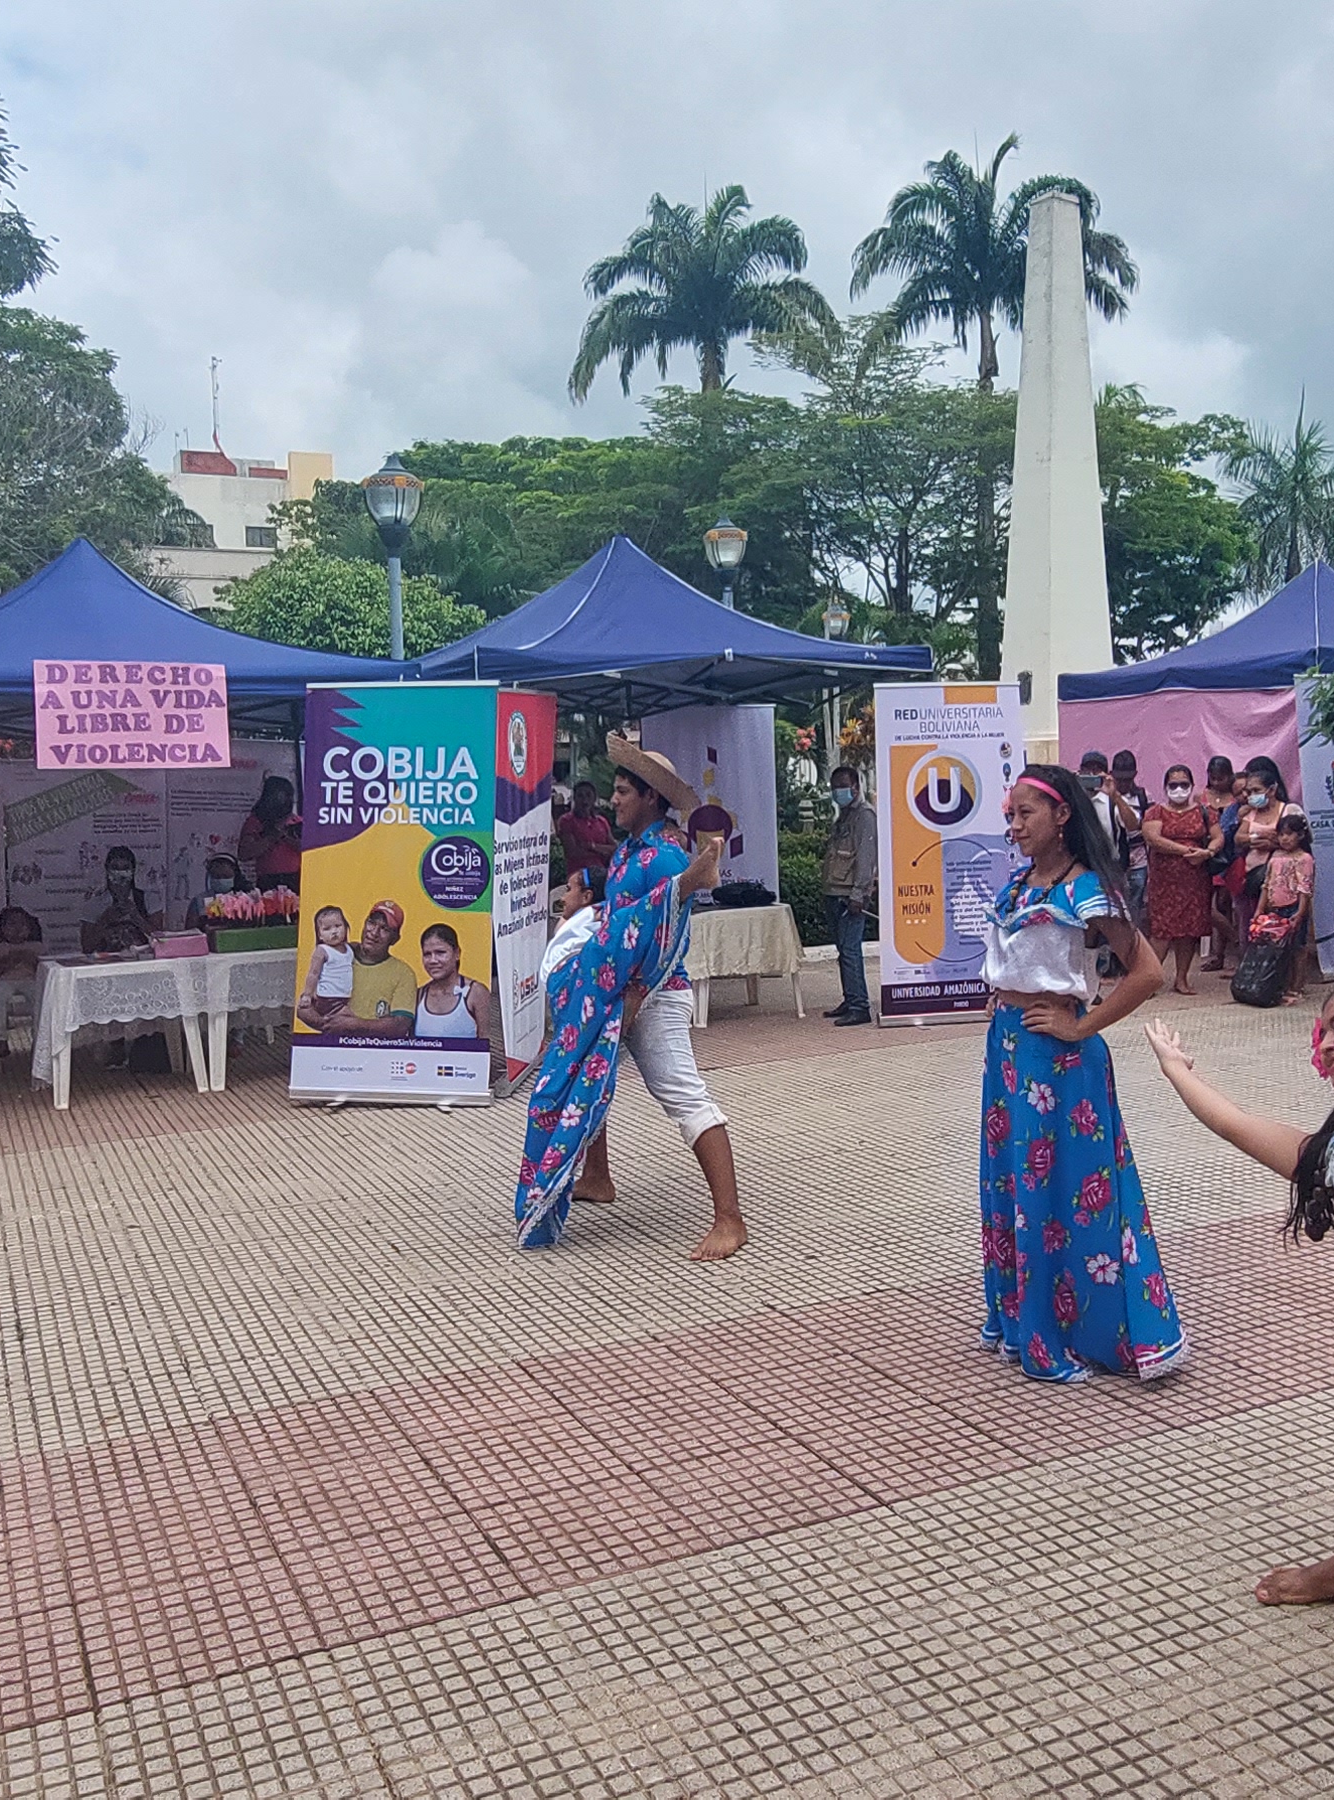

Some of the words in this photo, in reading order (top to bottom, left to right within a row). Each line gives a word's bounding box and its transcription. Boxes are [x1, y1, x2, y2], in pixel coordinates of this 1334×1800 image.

[45, 664, 213, 686] DERECHO
[40, 690, 65, 709] A
[70, 688, 142, 709] UNA
[148, 688, 226, 709] VIDA
[56, 712, 152, 734] LIBRE
[164, 713, 205, 734] DE
[894, 709, 918, 720] RED
[919, 707, 1004, 720] UNIVERSITARIA
[920, 720, 980, 733] BOLIVIANA
[49, 742, 222, 765] VIOLENCIA
[323, 746, 479, 780] COBIJA
[321, 782, 354, 804] TE
[363, 781, 478, 804] QUIERO
[928, 766, 961, 813] U
[318, 807, 352, 825] SIN
[359, 807, 475, 825] VIOLENCIA
[431, 844, 481, 876] Cobija
[898, 884, 935, 898] NUESTRA
[902, 902, 931, 916] MISIÓN
[891, 985, 941, 999] UNIVERSIDAD
[943, 981, 986, 996] AMAZÓNICA
